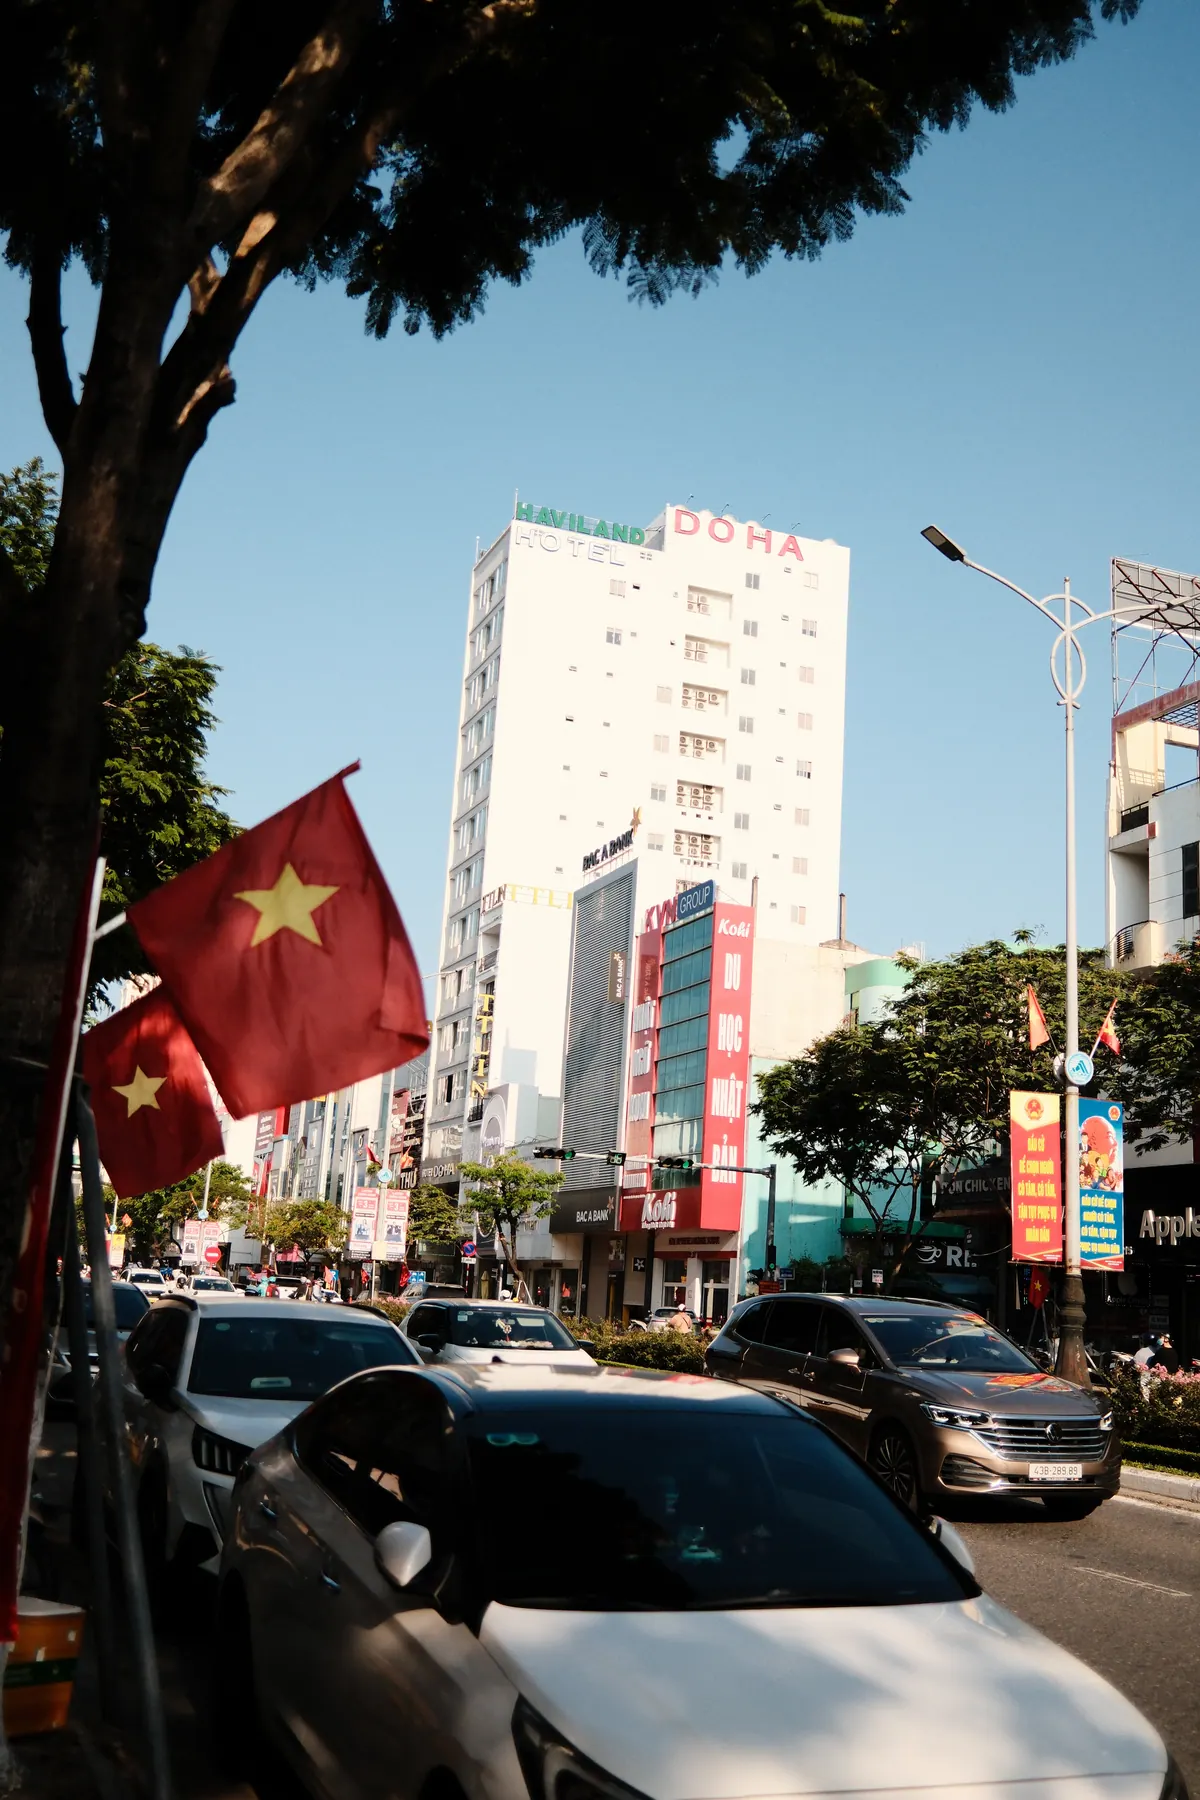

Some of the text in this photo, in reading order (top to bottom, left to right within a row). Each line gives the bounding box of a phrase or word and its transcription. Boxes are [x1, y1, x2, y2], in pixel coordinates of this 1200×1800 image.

[516, 501, 645, 545] HAVILAND
[674, 509, 804, 561] DOHA
[515, 525, 627, 566] HOTEL
[582, 828, 633, 871] BAC A BANK
[680, 885, 711, 913] GROUP
[718, 918, 751, 938] Kohi
[723, 952, 741, 991] DU
[471, 993, 495, 1097] TTLIN
[718, 1013, 743, 1058] HỌC
[711, 1072, 744, 1124] NHẬT
[434, 1163, 456, 1178] DOHA
[711, 1134, 738, 1184] BẢN
[576, 1209, 608, 1222] BAC A BANK
[1139, 1206, 1200, 1245] Apple
